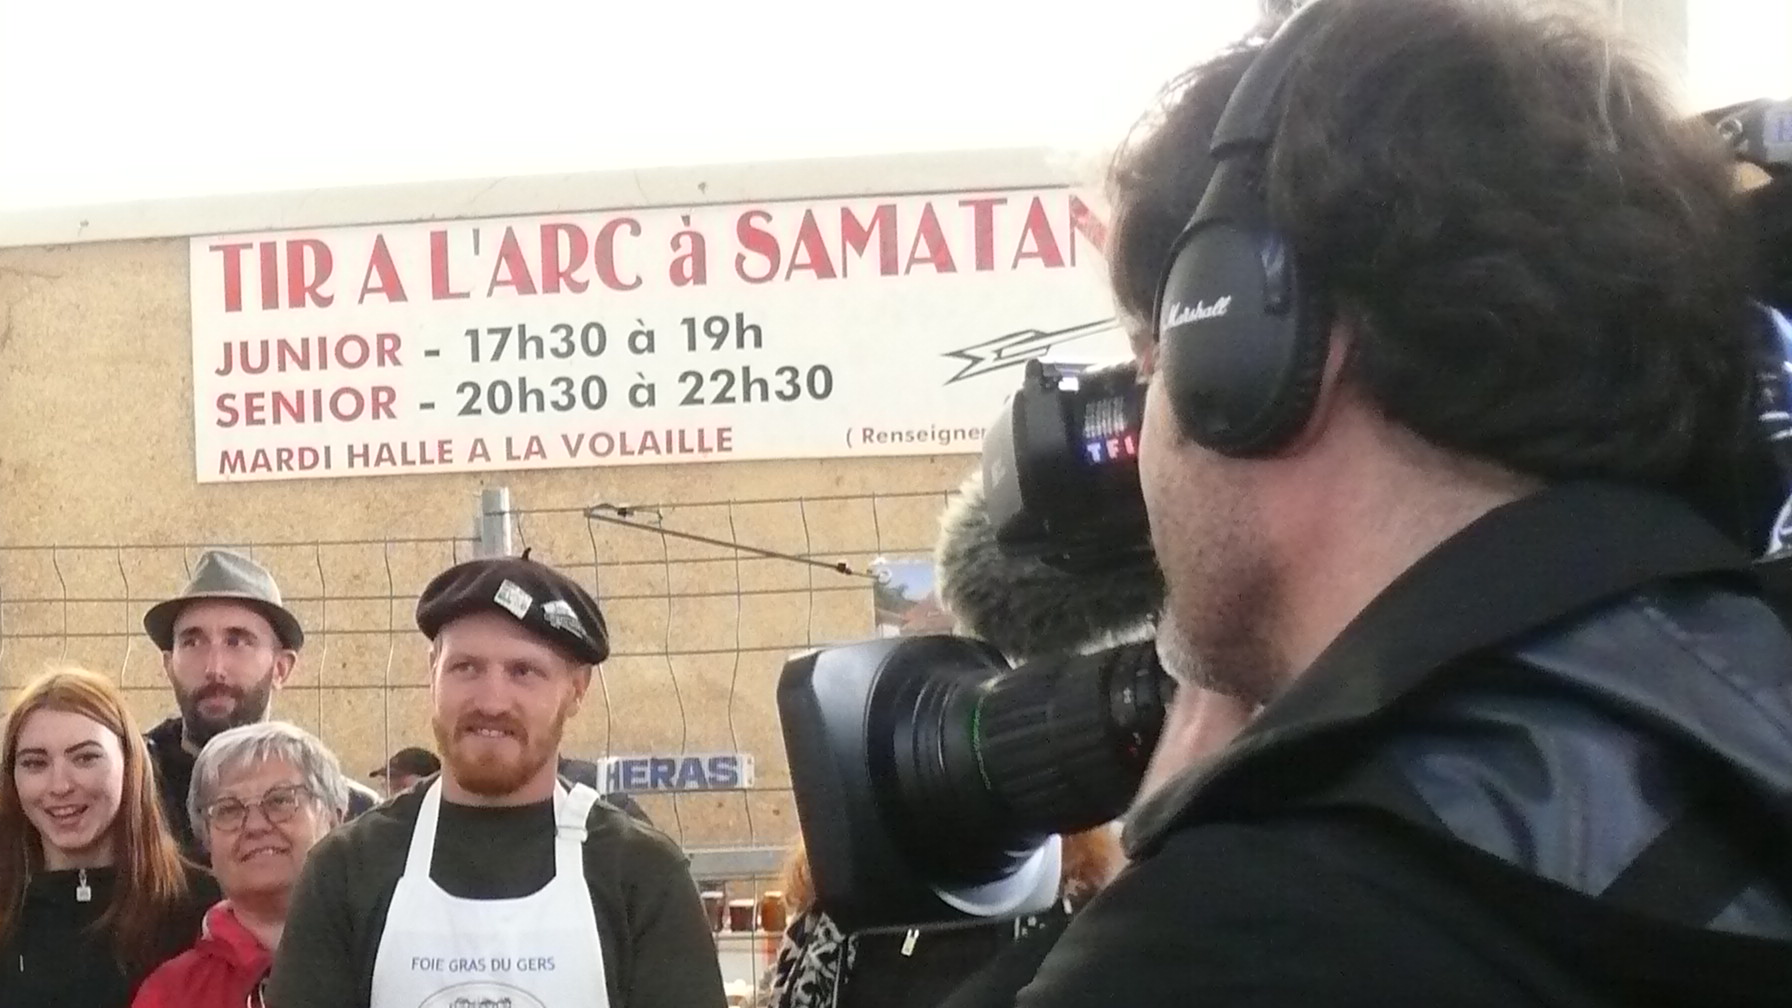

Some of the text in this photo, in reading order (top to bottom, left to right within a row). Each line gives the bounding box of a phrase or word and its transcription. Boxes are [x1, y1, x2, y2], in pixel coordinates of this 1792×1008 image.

[209, 236, 335, 313] TIR
[358, 232, 407, 306] A
[428, 217, 644, 303] L'ARC
[668, 214, 708, 288] à
[1162, 295, 1232, 331] Marshall
[215, 332, 403, 377] JUNIOR
[463, 318, 608, 363] 17h30
[627, 317, 657, 355] à
[680, 311, 765, 352] 19h
[215, 384, 397, 429] SENIOR
[455, 375, 608, 417] 20h30
[628, 367, 657, 411] à
[677, 363, 835, 406] 22h30
[218, 424, 733, 475] MARDI HALLE A LA VOLAILLE
[607, 756, 738, 789] HERAS
[411, 956, 556, 972] FOIE GRAS DU GERS
